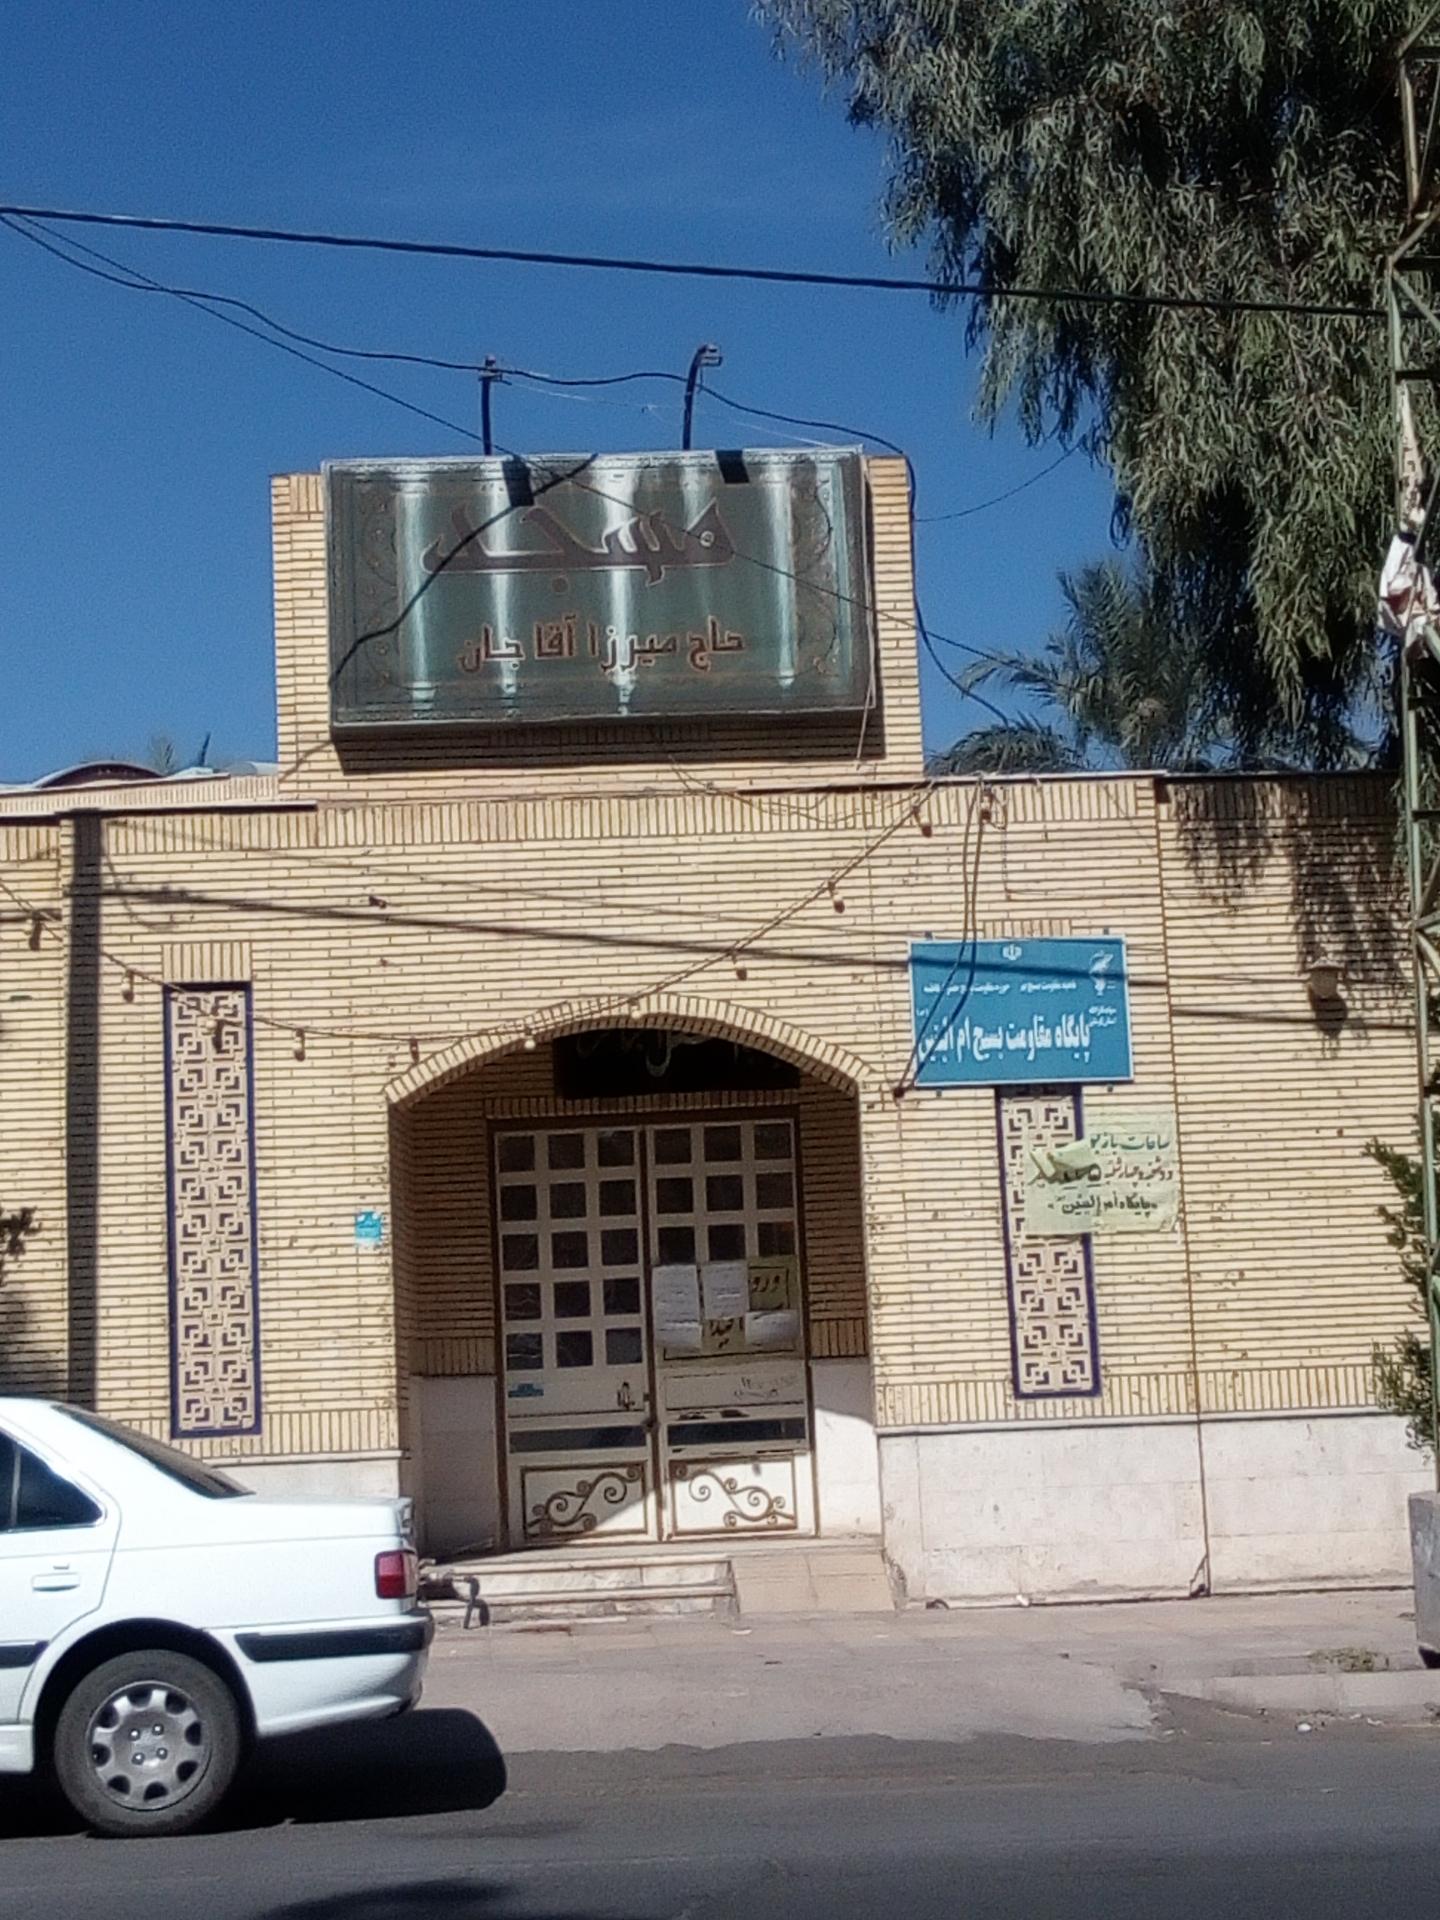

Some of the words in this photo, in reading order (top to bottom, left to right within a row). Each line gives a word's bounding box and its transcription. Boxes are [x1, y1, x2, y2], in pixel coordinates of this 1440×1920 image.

[420, 496, 736, 593] مسجد
[459, 622, 526, 673] جان
[534, 614, 577, 660] آقا
[587, 621, 677, 674] میرزا
[687, 615, 746, 672] حاج
[957, 1015, 971, 1063] ام
[972, 1025, 1004, 1062] بسیج
[1005, 1013, 1052, 1062] مقاومت
[1055, 1012, 1092, 1063] پایگاه
